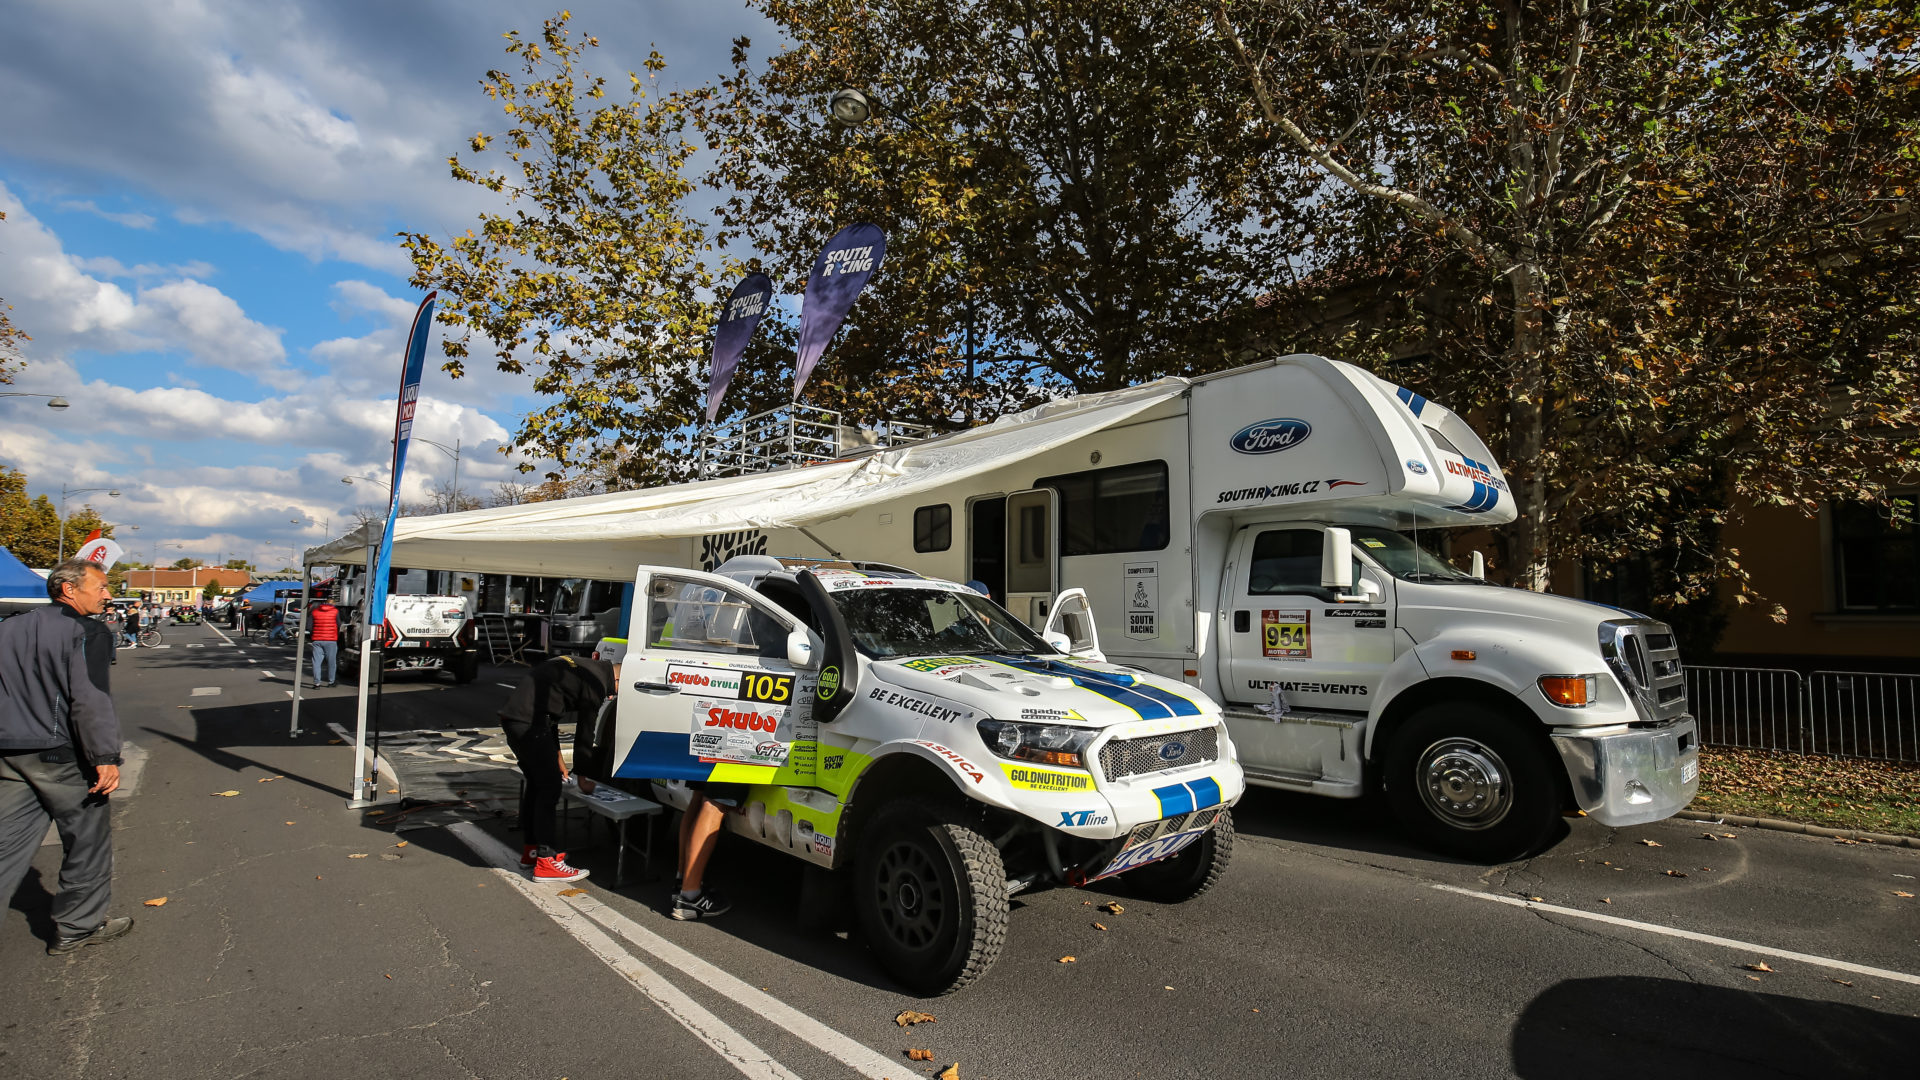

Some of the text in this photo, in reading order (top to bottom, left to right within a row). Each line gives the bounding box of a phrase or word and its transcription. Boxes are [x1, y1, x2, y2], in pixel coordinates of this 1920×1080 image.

[825, 246, 873, 264] SOUTH
[730, 292, 763, 311] SOUTH
[1243, 423, 1297, 451] Ford
[1409, 460, 1425, 473] Ford
[1130, 615, 1154, 625] SOUTH
[1130, 625, 1154, 634] RACING
[1266, 626, 1305, 646] 954
[822, 672, 838, 682] GOLD
[710, 679, 739, 690] GYULA
[745, 674, 791, 702] 105
[869, 687, 961, 723] BE EXCELLENT
[1022, 708, 1069, 716] agados
[1164, 743, 1183, 759] Ford
[824, 754, 844, 764] SOUTH
[1011, 769, 1088, 789] GOLDNUTRITION
[1038, 784, 1069, 792] EXCELLENT
[1056, 810, 1108, 827] XTline
[815, 833, 831, 847] LIQUI
[815, 842, 832, 856] MOLY
